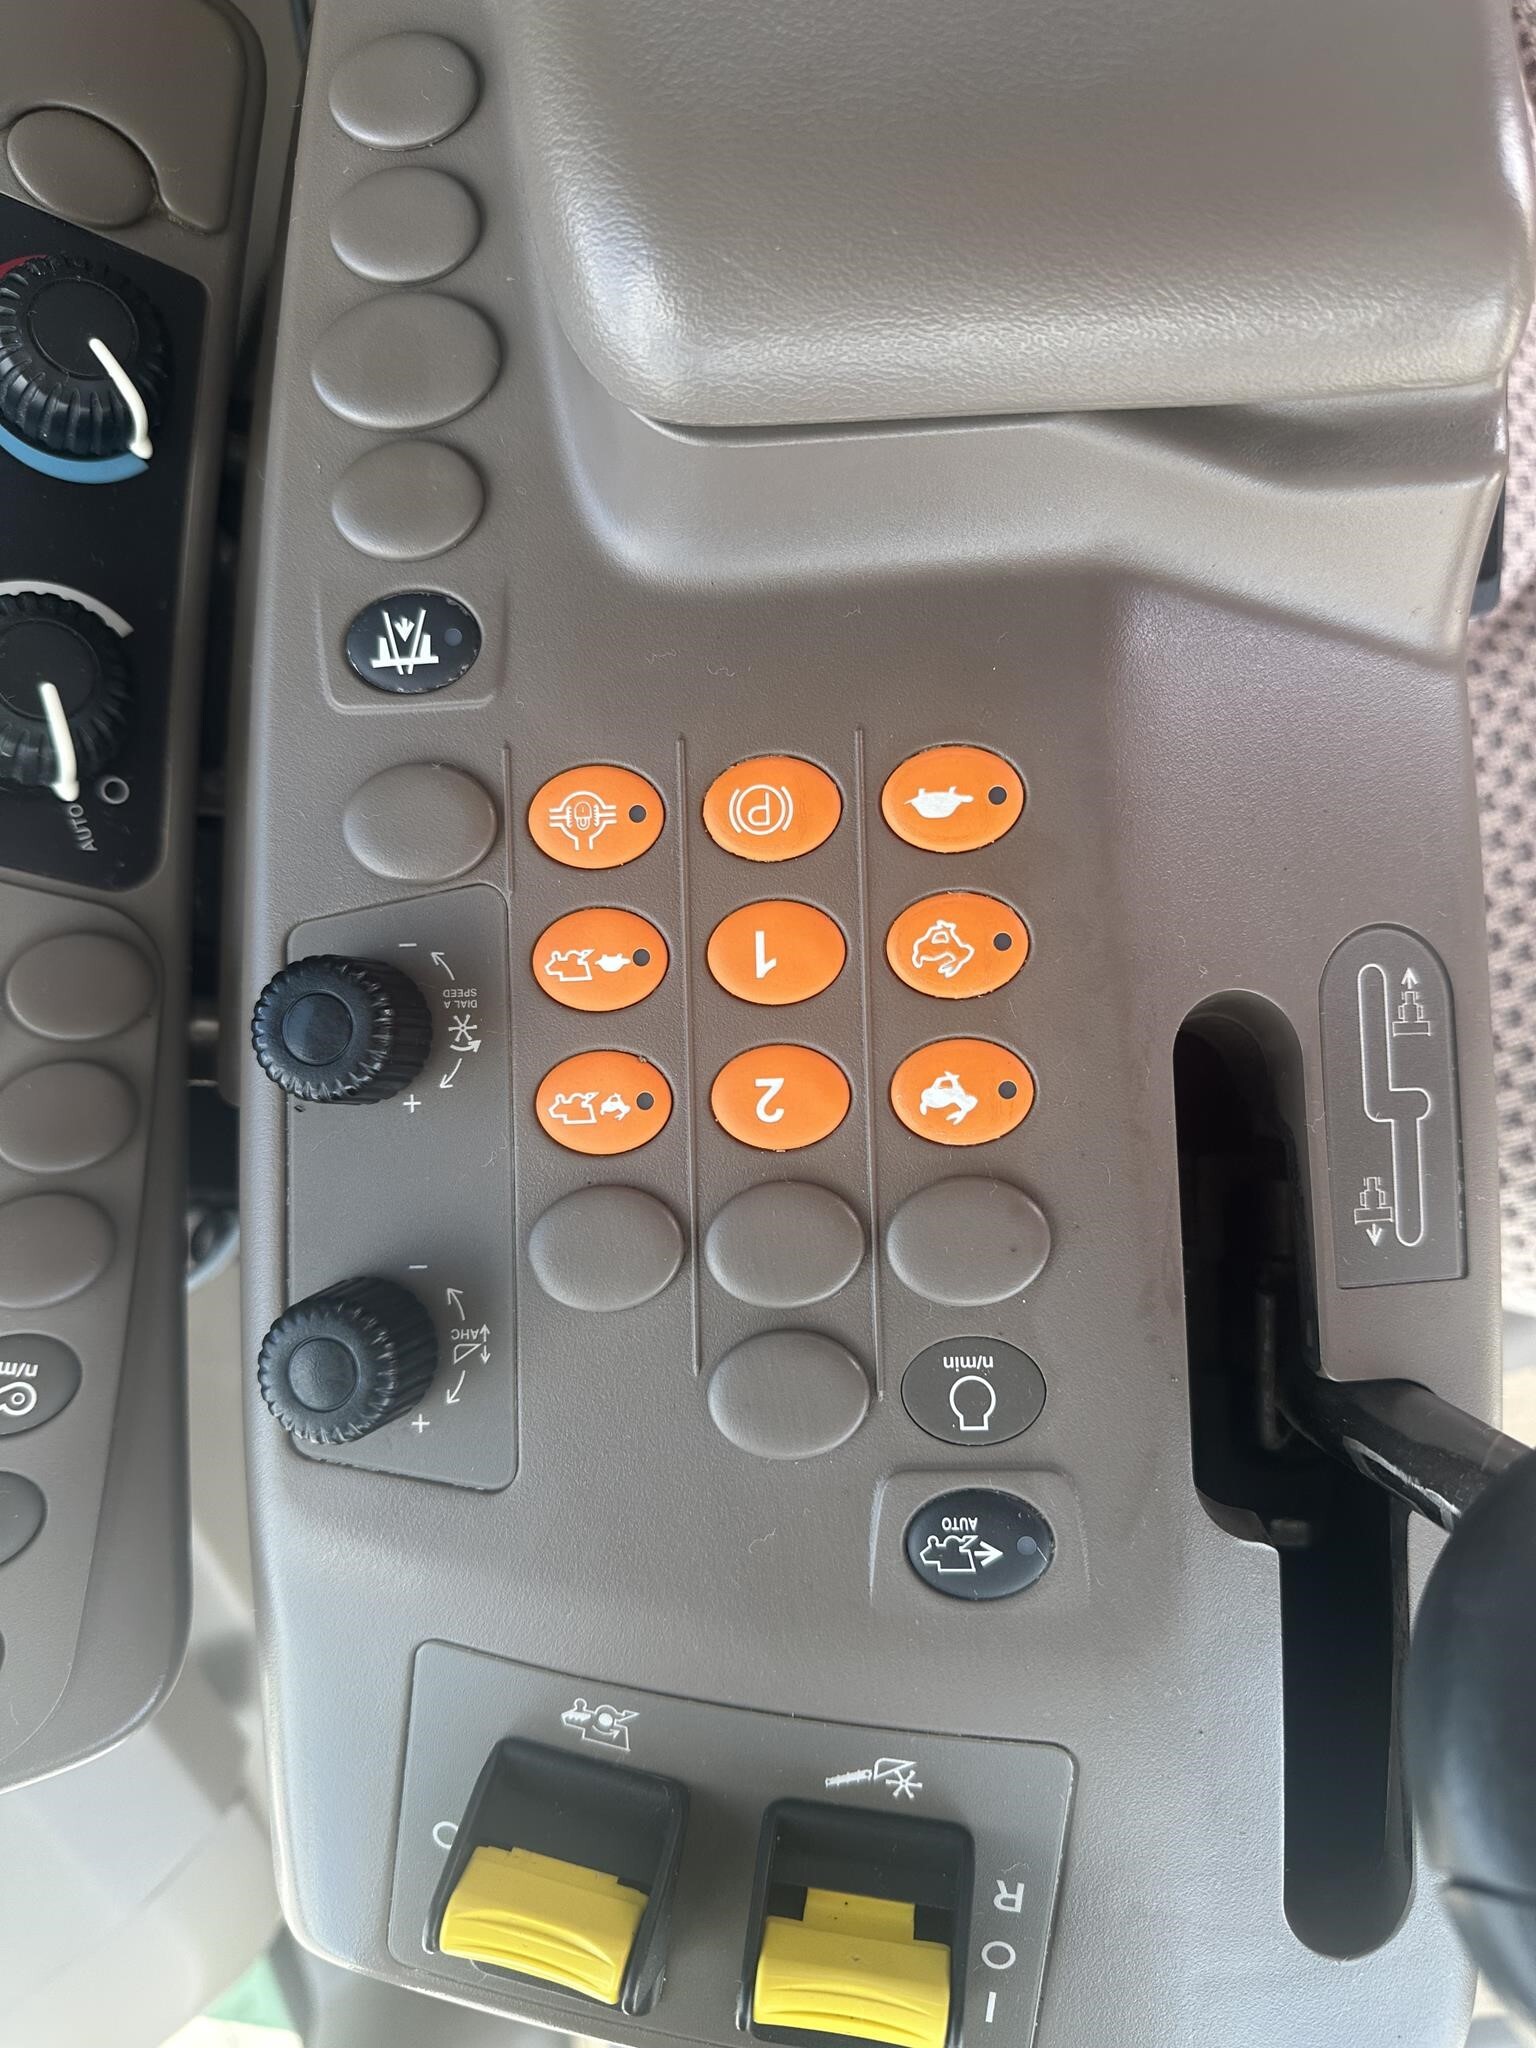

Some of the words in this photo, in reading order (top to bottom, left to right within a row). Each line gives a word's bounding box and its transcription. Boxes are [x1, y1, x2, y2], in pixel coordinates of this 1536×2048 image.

[69, 803, 98, 851] AUTO
[755, 930, 777, 979] 1
[442, 988, 478, 998] SPEED
[444, 999, 451, 1009] A
[456, 999, 478, 1009] DIAL
[754, 1077, 785, 1124] 2
[450, 1328, 480, 1341] AHC
[943, 1355, 994, 1372] n/min
[941, 1516, 978, 1531] AUTO
[993, 1879, 1025, 1913] R
